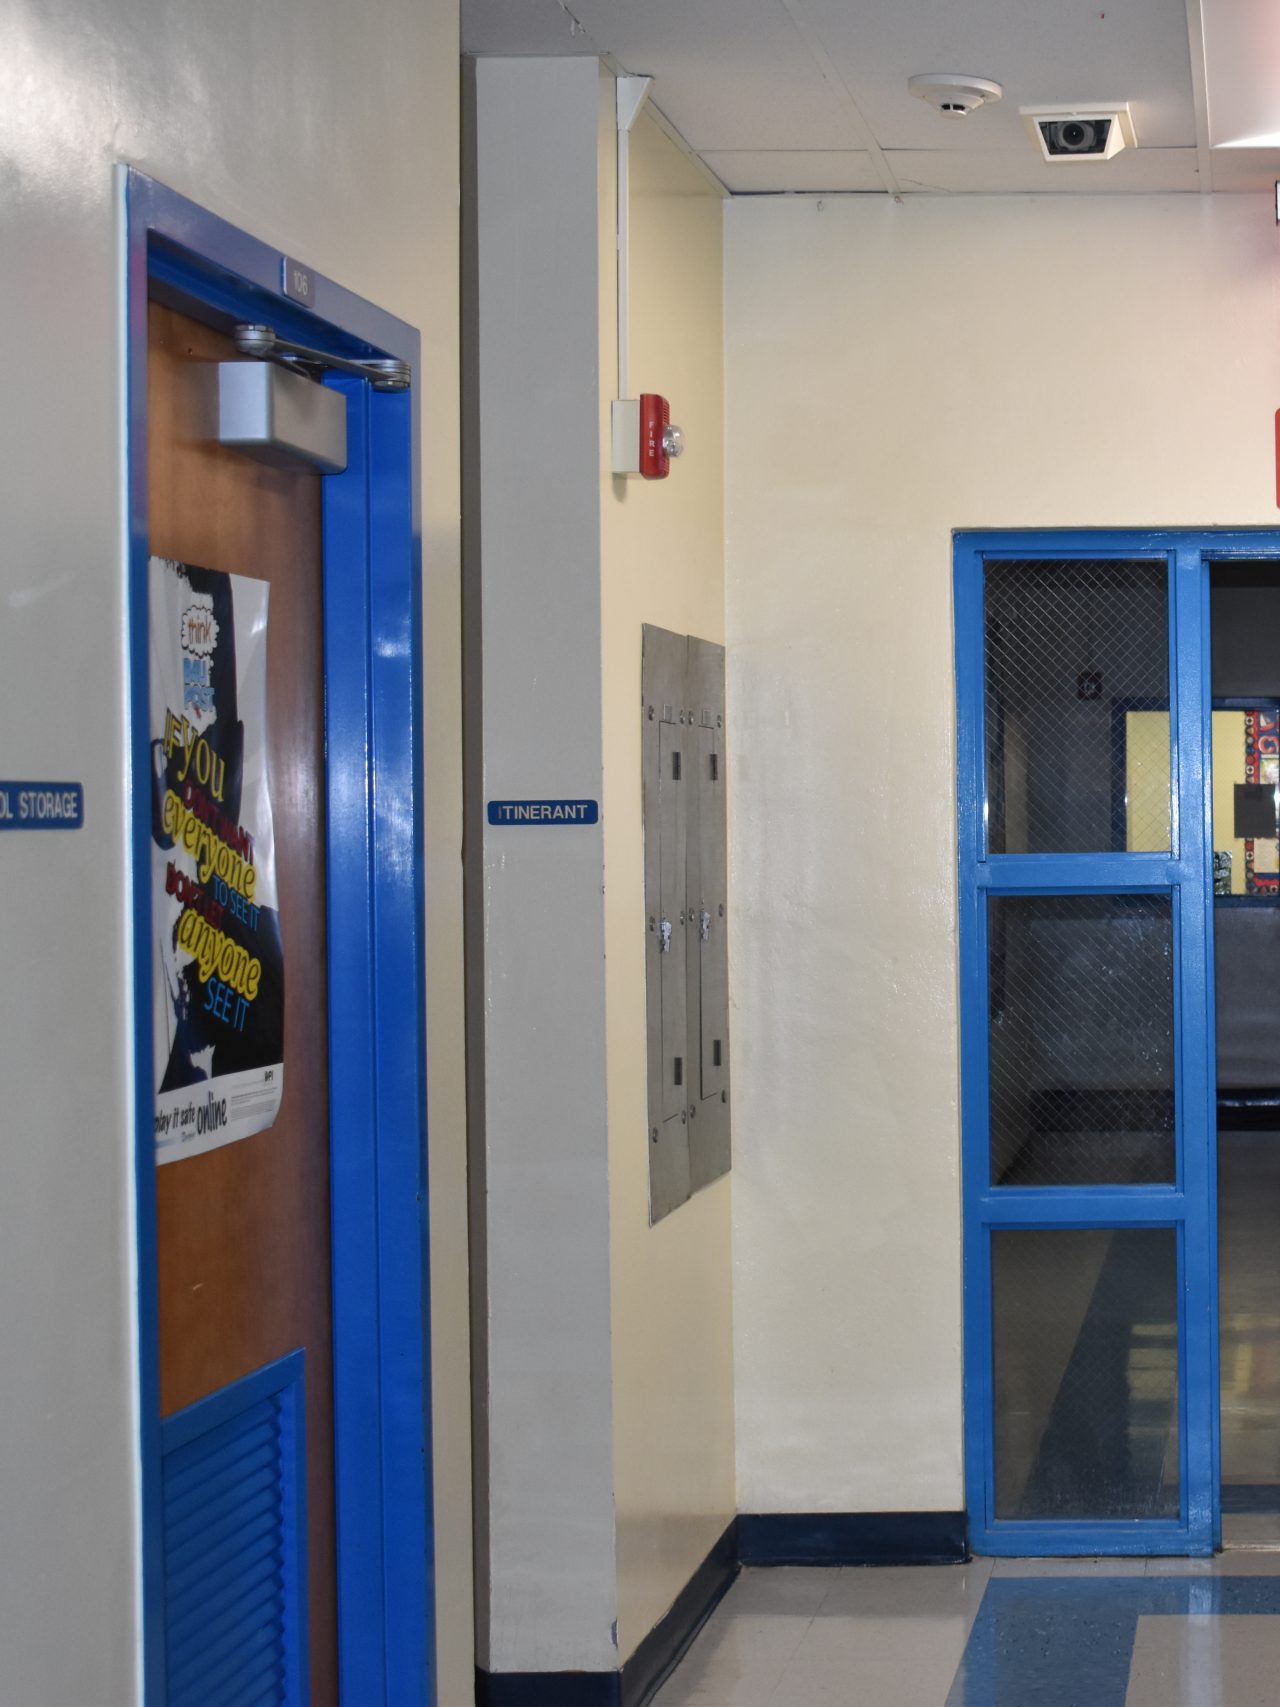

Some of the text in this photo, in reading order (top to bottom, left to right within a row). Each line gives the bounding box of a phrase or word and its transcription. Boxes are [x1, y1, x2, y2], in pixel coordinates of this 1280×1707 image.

[648, 421, 656, 457] FIRE
[188, 614, 212, 645] think
[177, 714, 225, 802] you
[18, 791, 78, 819] STORAGE
[498, 805, 588, 820] ITINERANT
[162, 789, 257, 904] everyone
[212, 873, 260, 932] TO SEE IT
[177, 907, 261, 1001] anyone
[203, 976, 250, 1032] SEE IT
[180, 1101, 196, 1127] safe
[197, 1090, 227, 1135] online
